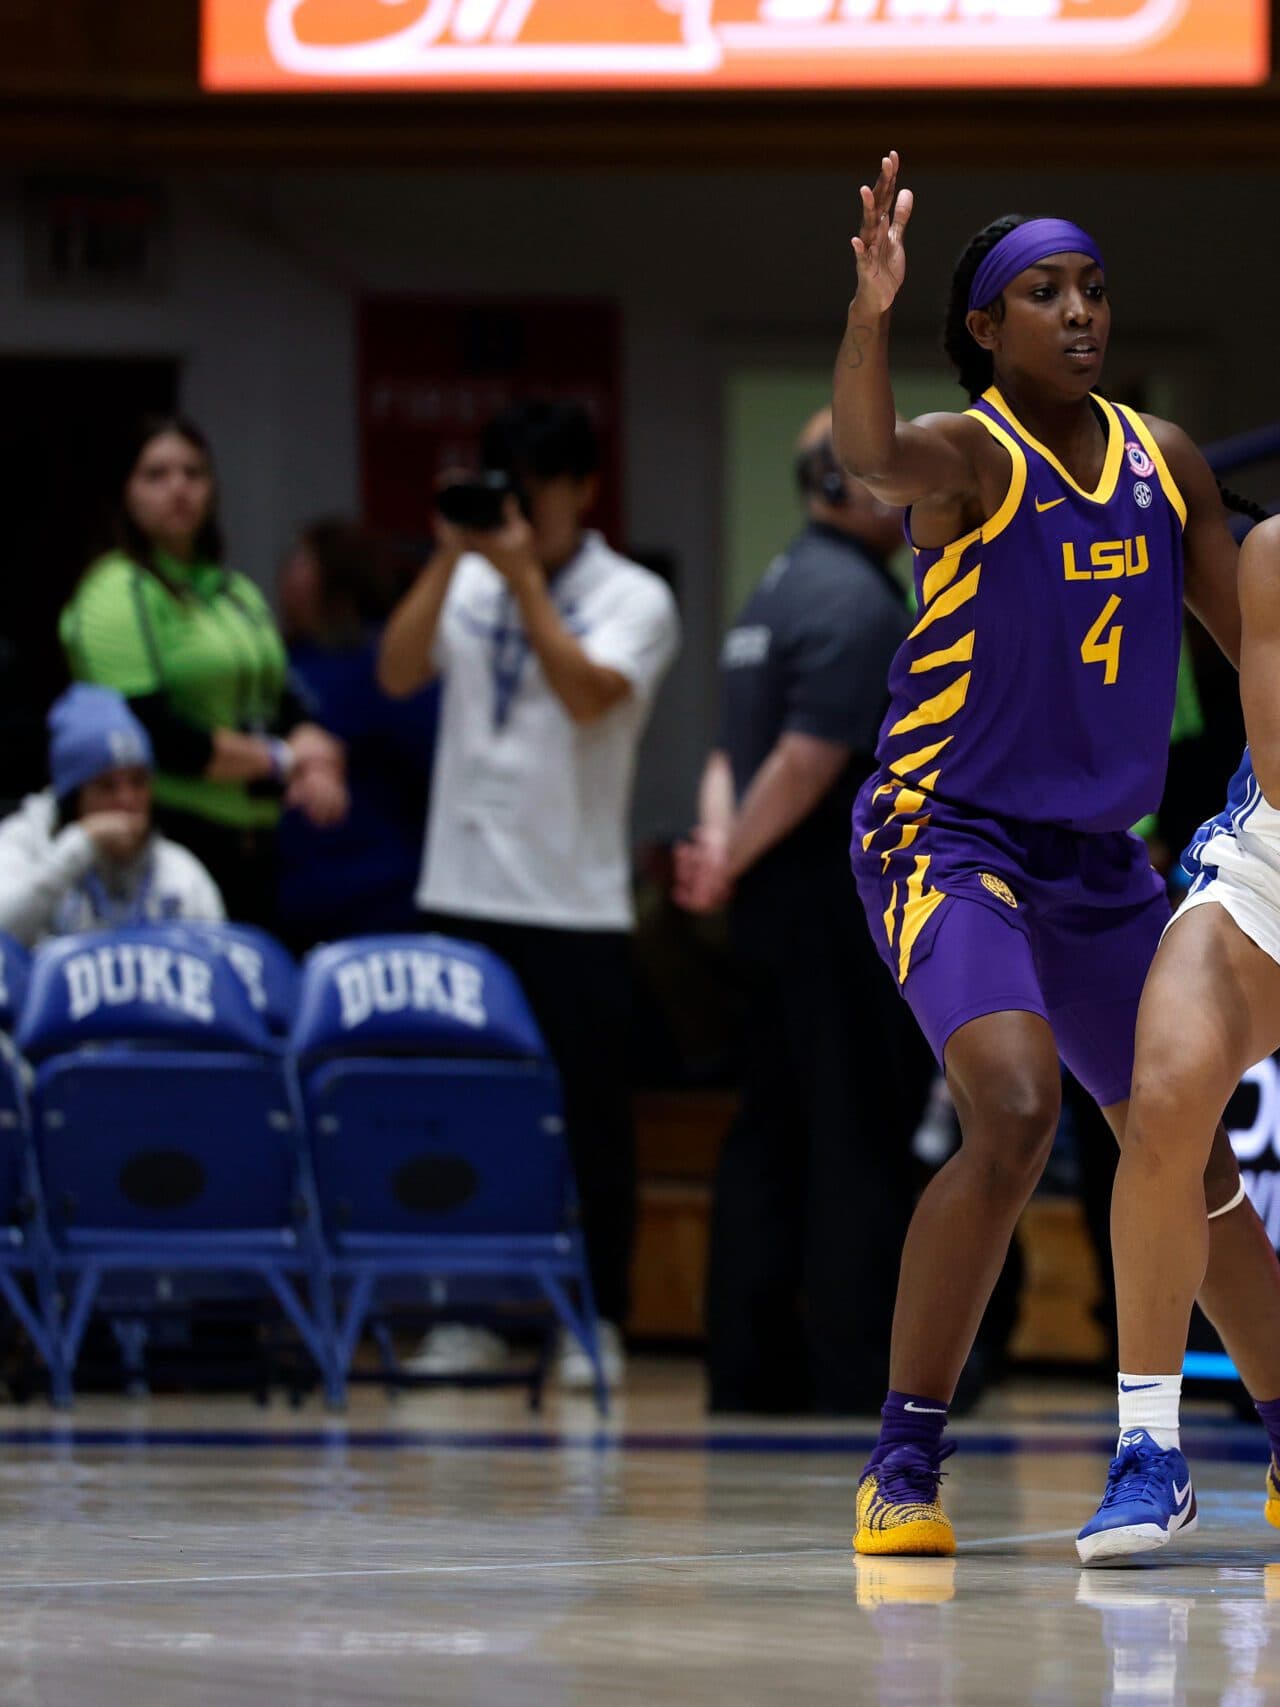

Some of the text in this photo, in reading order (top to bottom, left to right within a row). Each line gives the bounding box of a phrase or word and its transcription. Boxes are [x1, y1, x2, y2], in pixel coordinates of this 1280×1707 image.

[1062, 535, 1149, 580] LSU
[1080, 594, 1124, 685] 4
[66, 943, 215, 1023] DUKE
[336, 950, 488, 1030] DUKE
